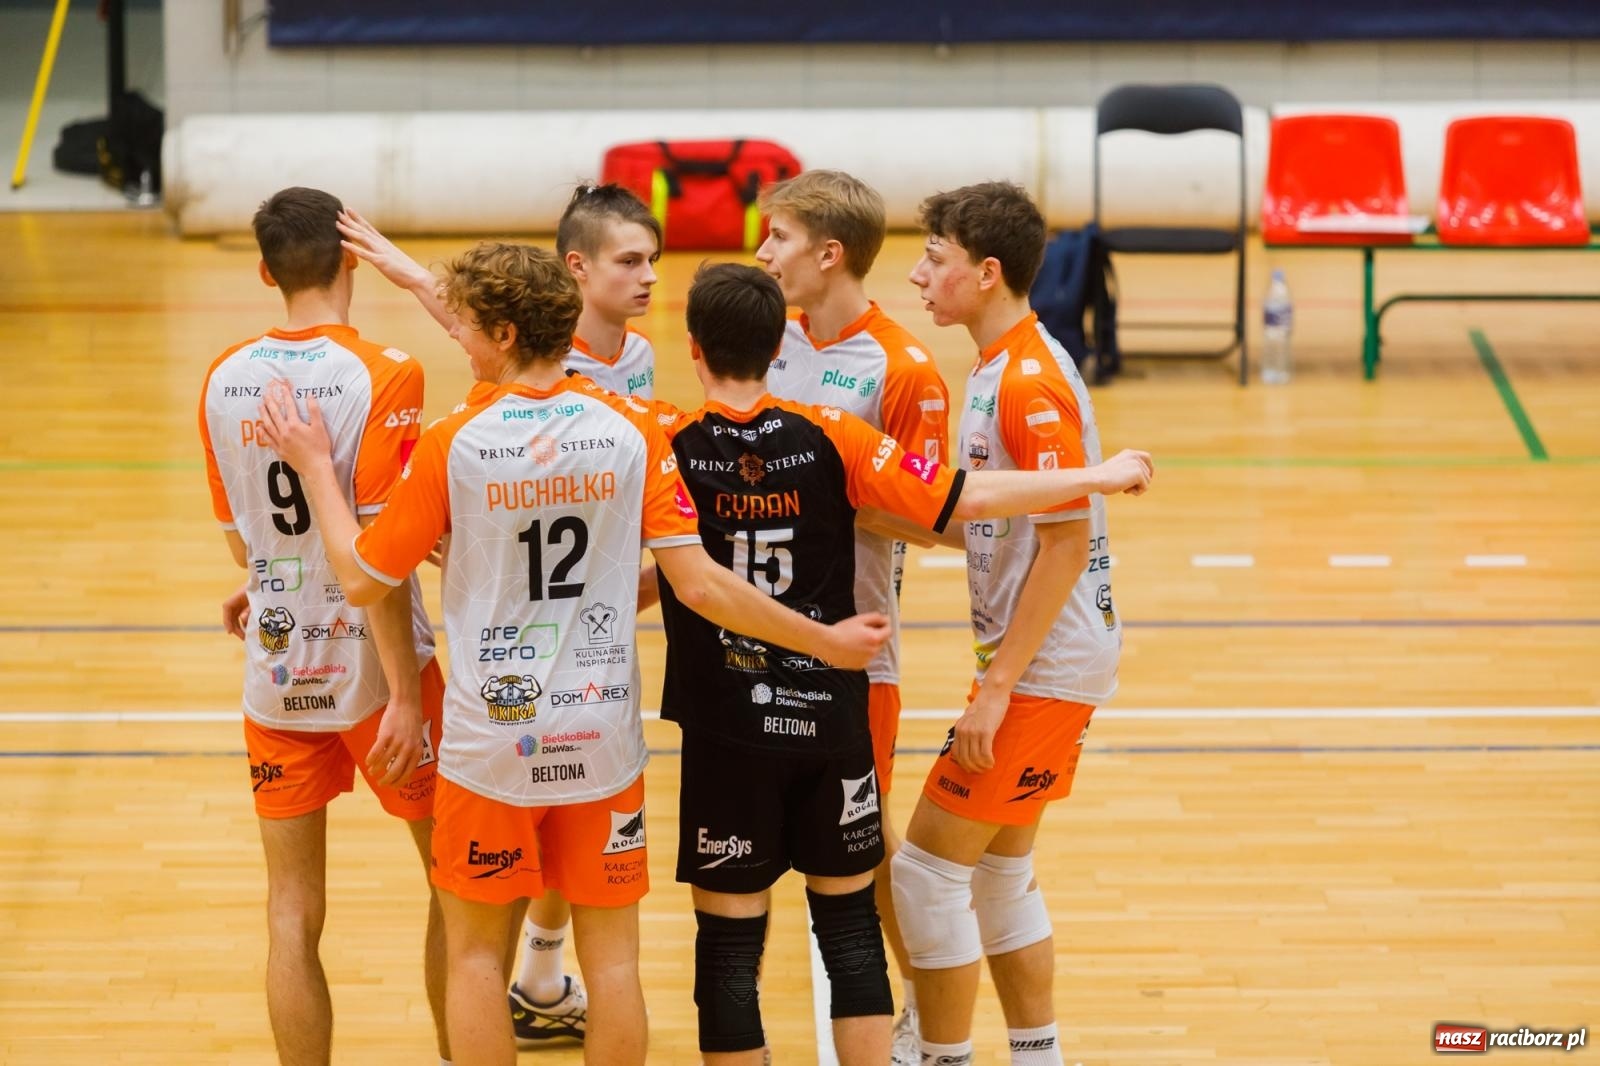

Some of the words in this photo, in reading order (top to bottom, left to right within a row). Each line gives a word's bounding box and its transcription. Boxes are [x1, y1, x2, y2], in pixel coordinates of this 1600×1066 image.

[249, 347, 280, 360] plus
[627, 373, 647, 395] plus
[821, 369, 857, 390] plus
[224, 387, 261, 398] PRINZ
[296, 384, 344, 399] STEFAN
[503, 409, 534, 422] plus
[555, 402, 585, 417] liga
[479, 446, 525, 460] PRINZ
[560, 437, 616, 453] STEFAN
[690, 458, 735, 473] PRINZ
[765, 451, 816, 473] STEFAN
[268, 460, 312, 536] 9
[487, 471, 615, 512] PUCHAŁKA
[517, 516, 589, 602] 12
[725, 527, 795, 597] 15
[480, 626, 519, 646] pre
[478, 645, 536, 662] zero
[575, 647, 626, 659] KULINARNE
[576, 657, 628, 668] INSPIRACJE
[283, 694, 336, 712] BELTONA
[551, 682, 630, 707] DOMAREX
[487, 702, 537, 721] VIKINGA
[763, 716, 817, 738] BELTONA
[532, 763, 586, 783] BELTONA
[468, 840, 523, 868] EnerSys
[697, 828, 753, 859] EnerSys
[847, 835, 880, 853] ROGATA
